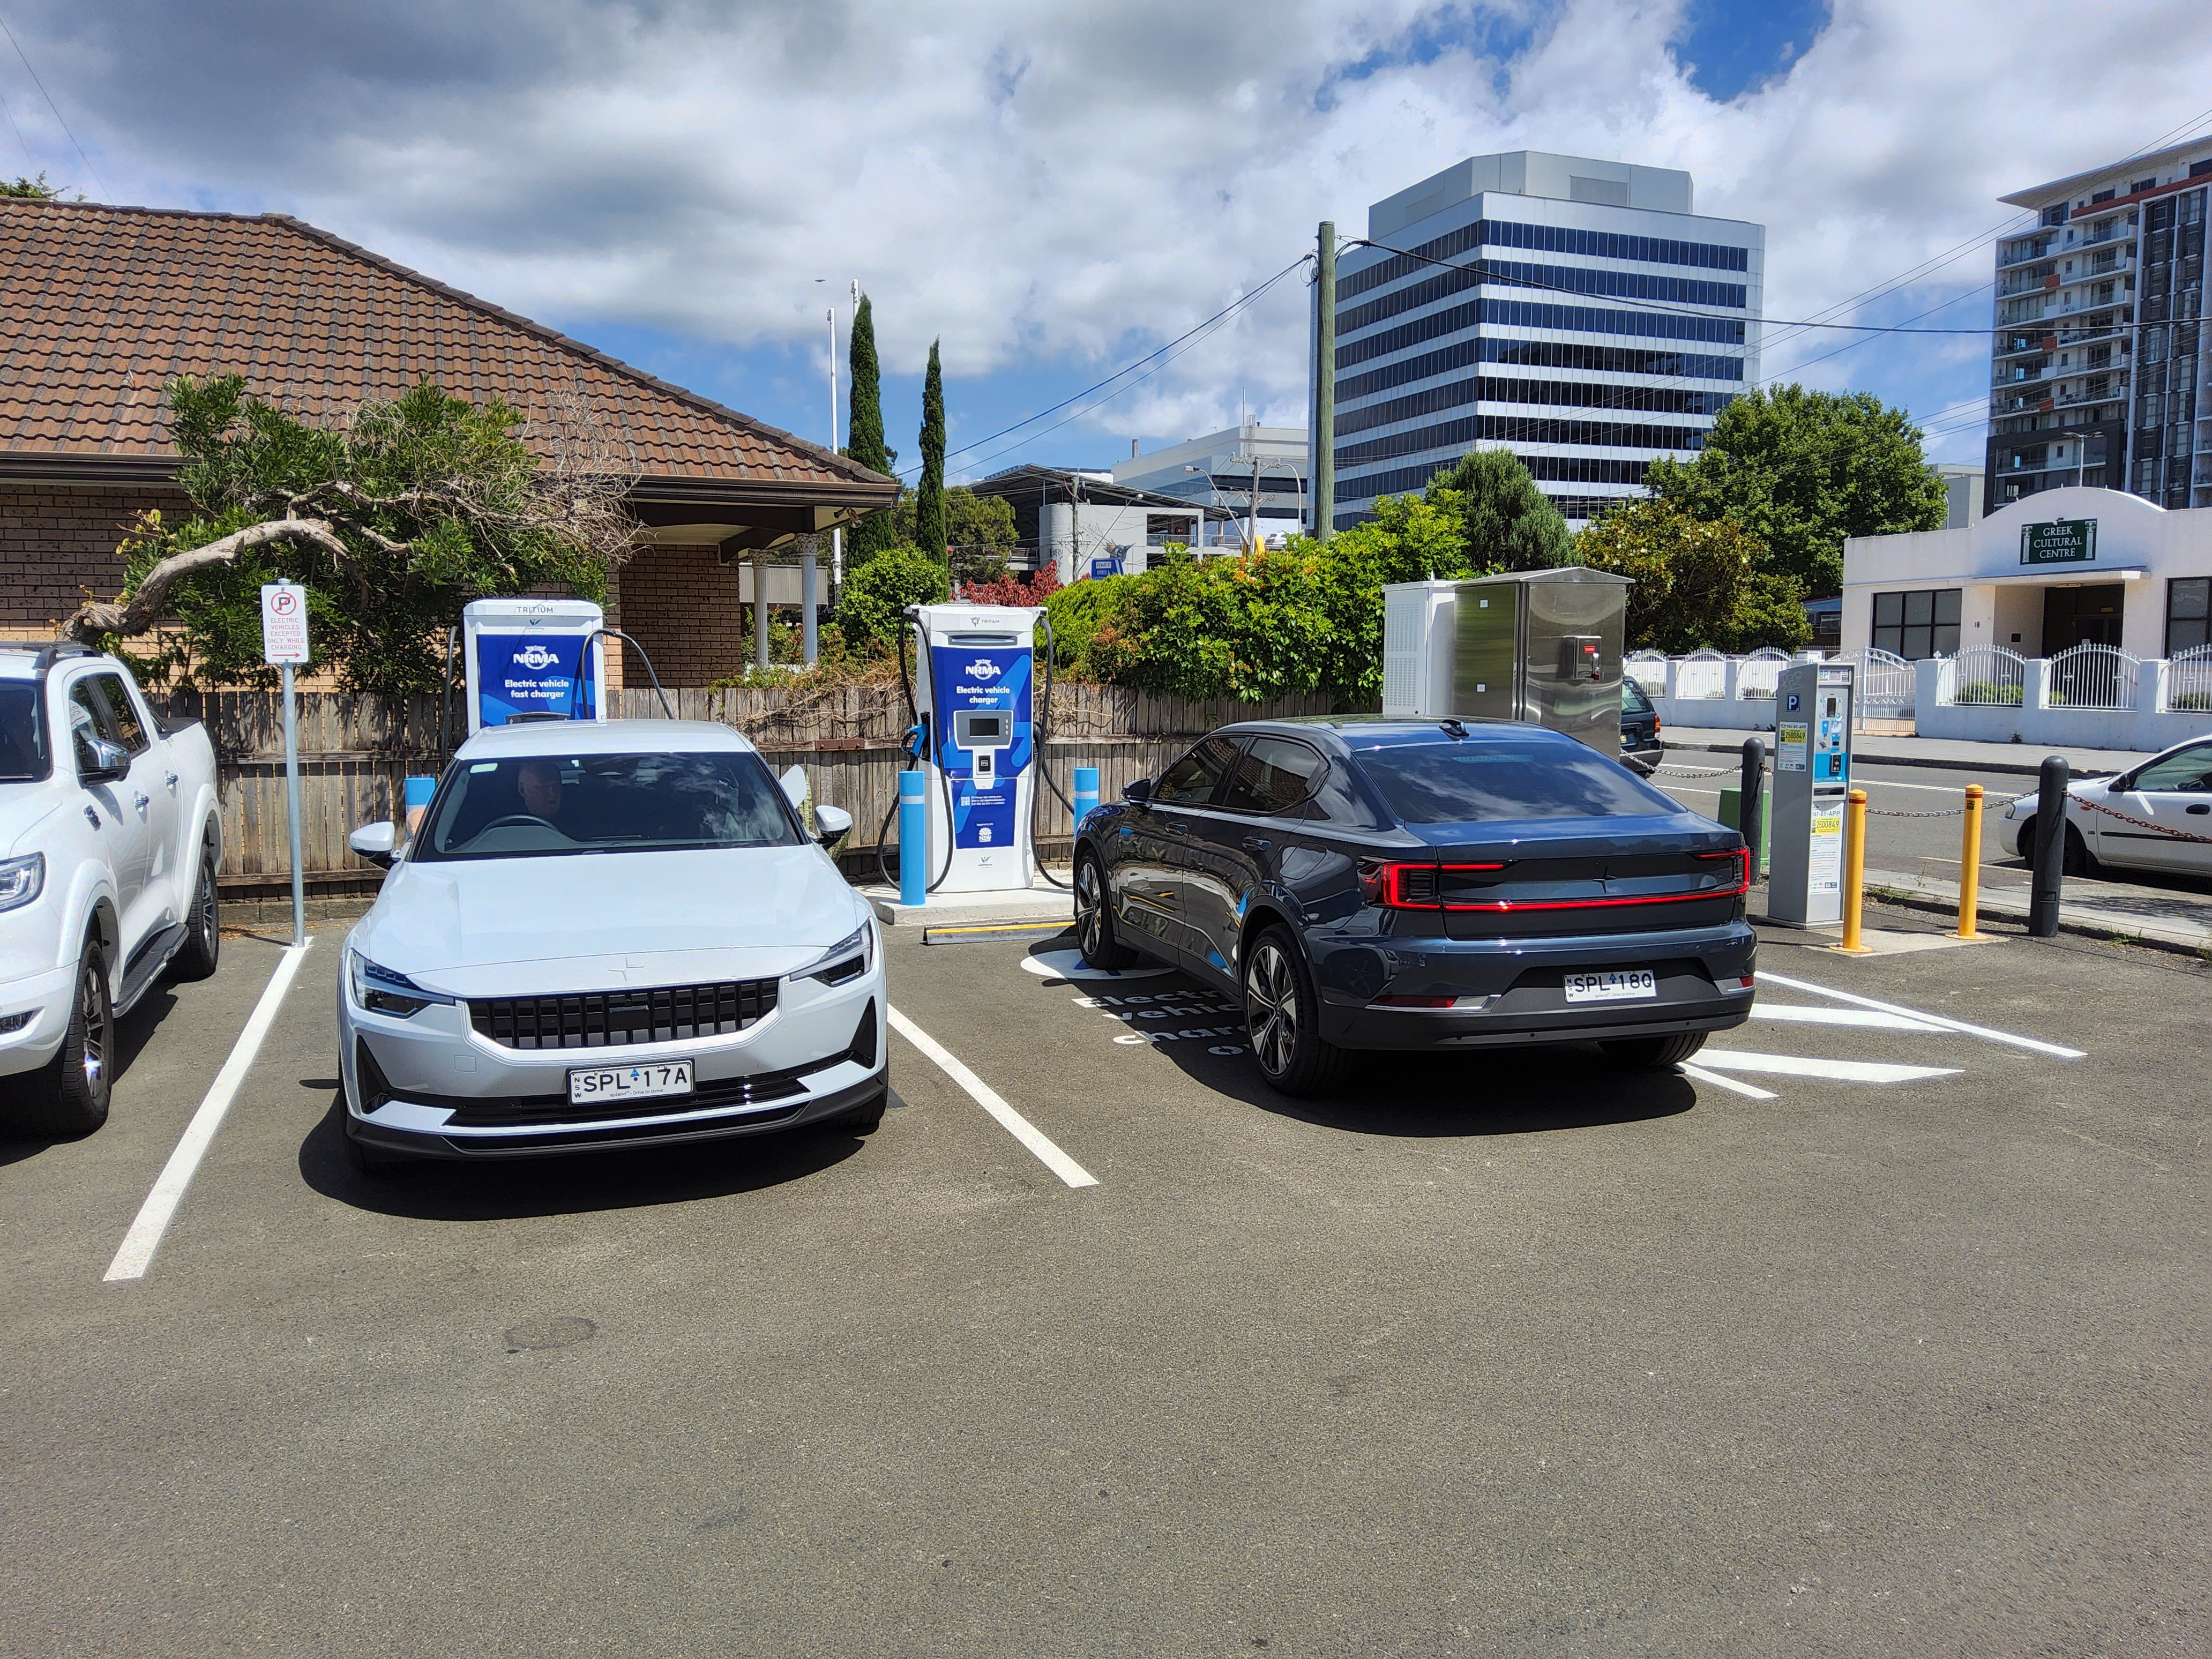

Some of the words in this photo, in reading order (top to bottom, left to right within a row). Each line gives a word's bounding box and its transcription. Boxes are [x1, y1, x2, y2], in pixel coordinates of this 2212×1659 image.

[2043, 526, 2073, 536] GREEK
[2034, 537, 2082, 548] CULTURAL
[2039, 548, 2075, 558] CENTRE
[513, 653, 559, 664] NRMA
[965, 666, 1001, 675] NRMA
[505, 679, 537, 687] Electric
[539, 679, 570, 687] vehicle
[530, 690, 565, 699] charger
[956, 686, 983, 694] Electric
[985, 686, 1010, 694] vehicle
[969, 696, 998, 705] charger
[1788, 696, 1797, 710] P
[1817, 820, 1840, 828] 2500849
[1071, 991, 1218, 1008] Electr
[1102, 1003, 1244, 1020] vehic
[1113, 1025, 1247, 1044] char
